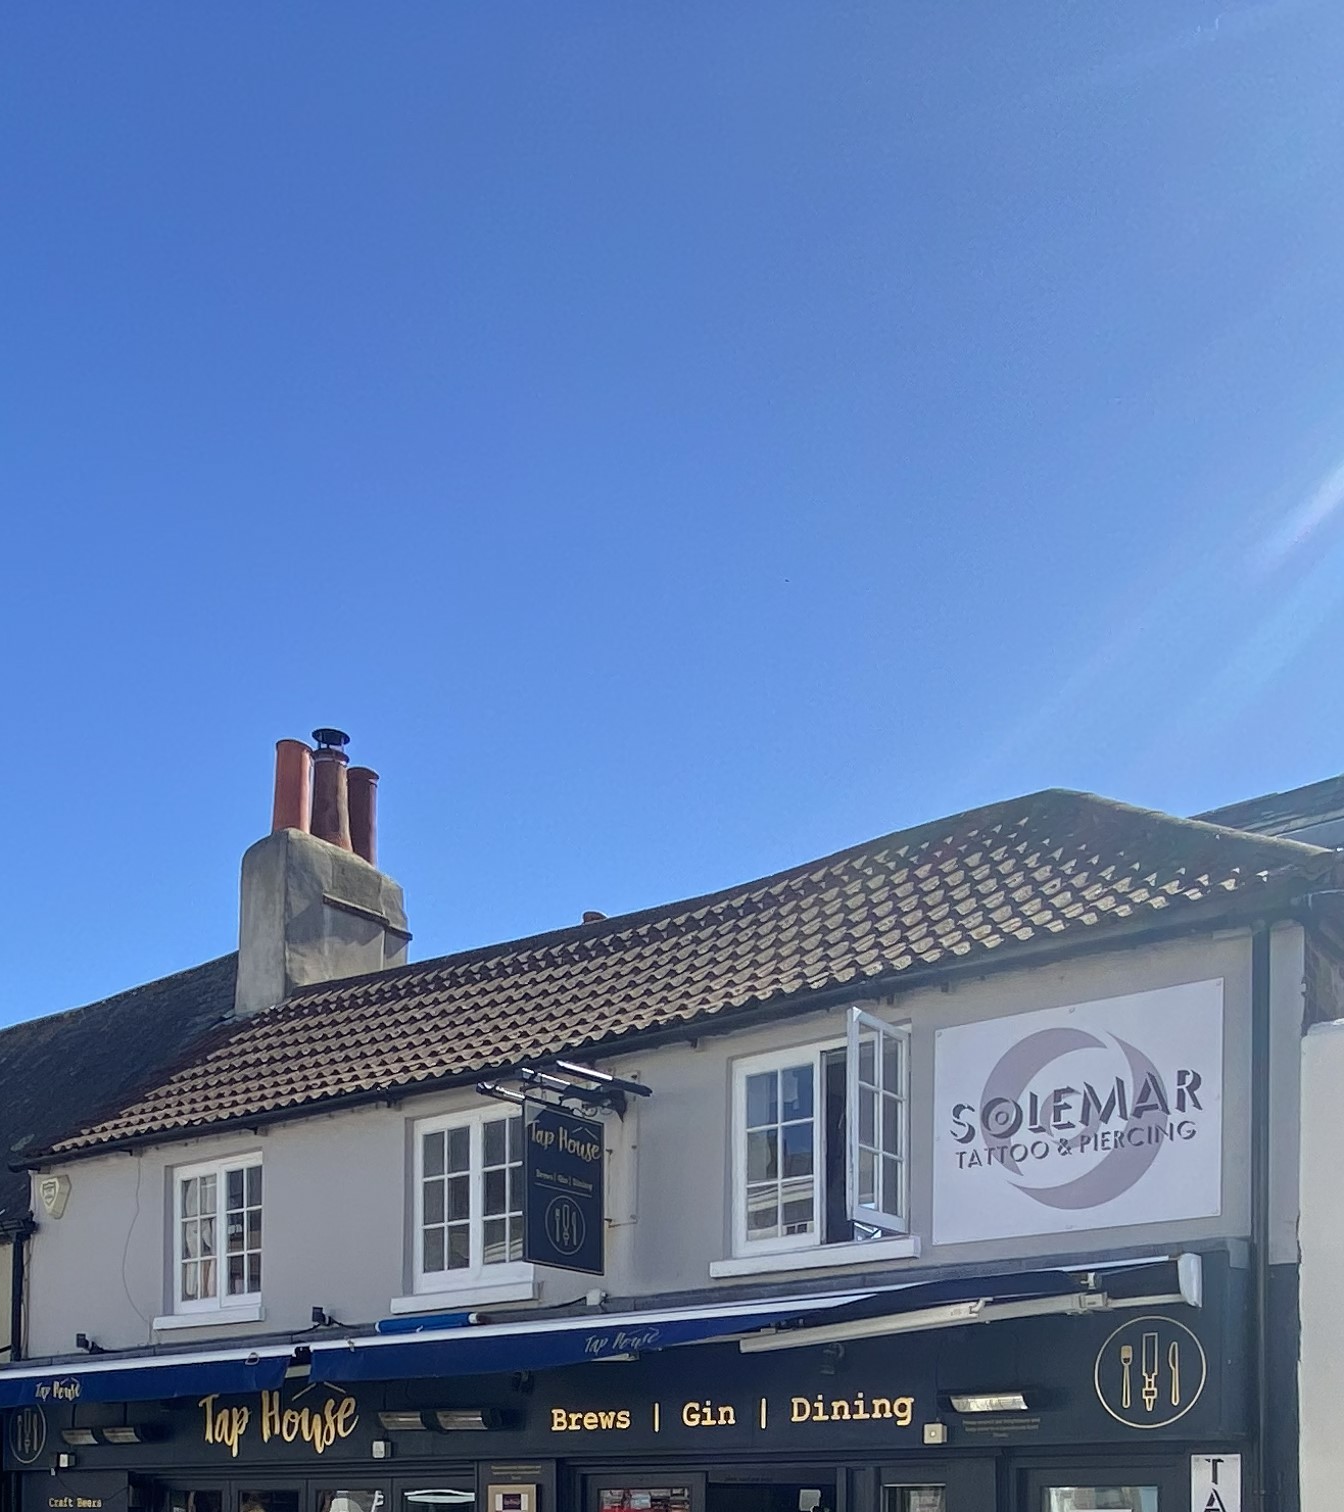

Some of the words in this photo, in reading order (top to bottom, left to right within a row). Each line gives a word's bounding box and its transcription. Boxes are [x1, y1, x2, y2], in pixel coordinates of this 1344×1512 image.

[950, 1069, 1203, 1144] SOLEMAR
[526, 1120, 555, 1150] Tap
[558, 1126, 602, 1163] House
[955, 1141, 1050, 1170] TATTOO
[1057, 1137, 1072, 1156] &
[1080, 1120, 1197, 1154] PIERCING
[198, 1393, 252, 1458] Tap
[261, 1390, 359, 1454] House
[551, 1407, 631, 1431] Brews
[682, 1399, 736, 1427] Gin
[790, 1392, 915, 1427] Dining
[48, 1497, 74, 1508] Craft
[76, 1498, 102, 1508] Beers
